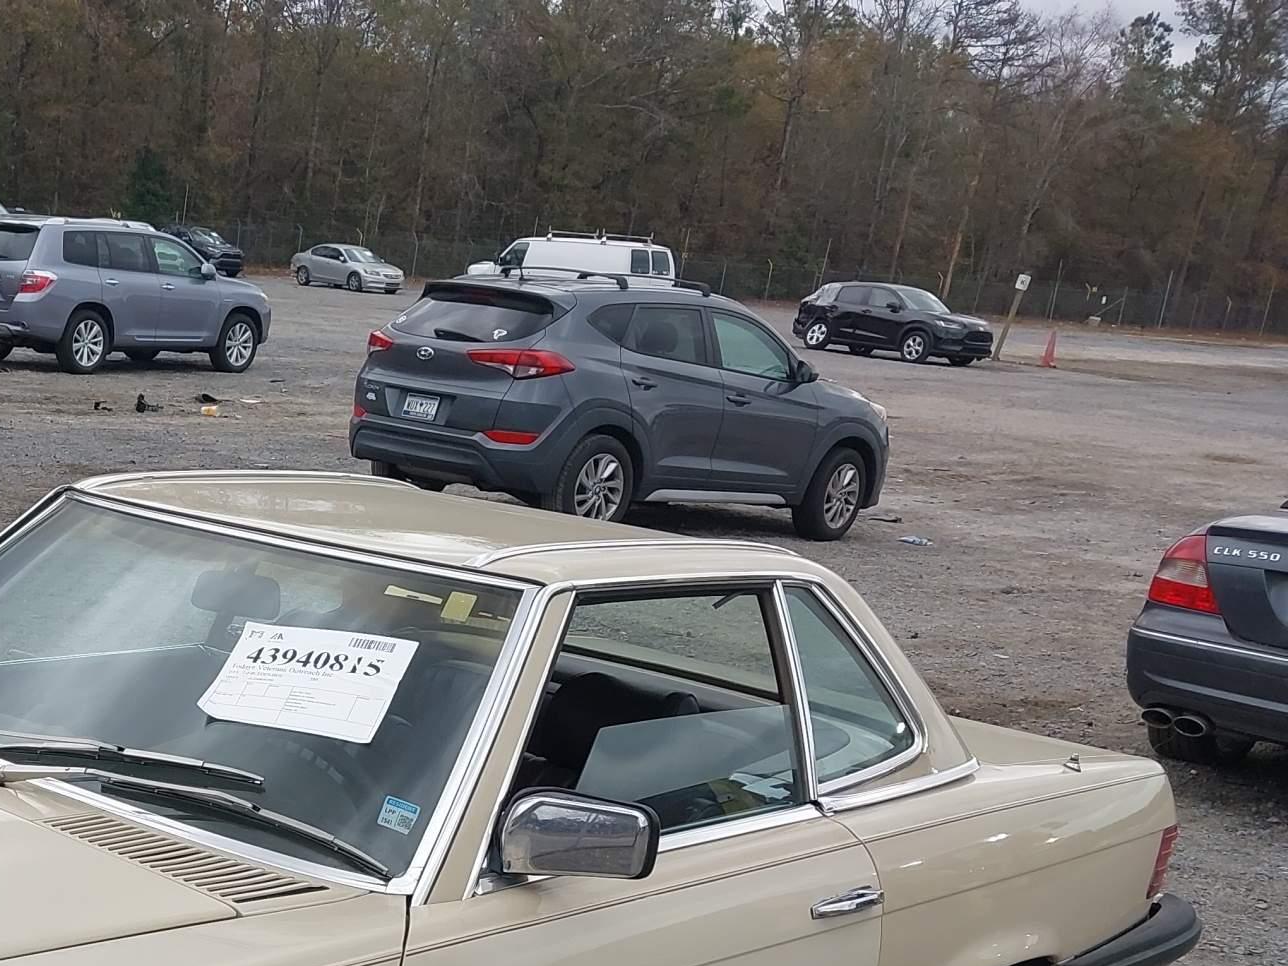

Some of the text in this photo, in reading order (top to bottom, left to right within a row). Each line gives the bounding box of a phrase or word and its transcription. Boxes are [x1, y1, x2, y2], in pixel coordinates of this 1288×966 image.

[1214, 546, 1281, 561] CLK 550
[246, 646, 385, 677] 43940815
